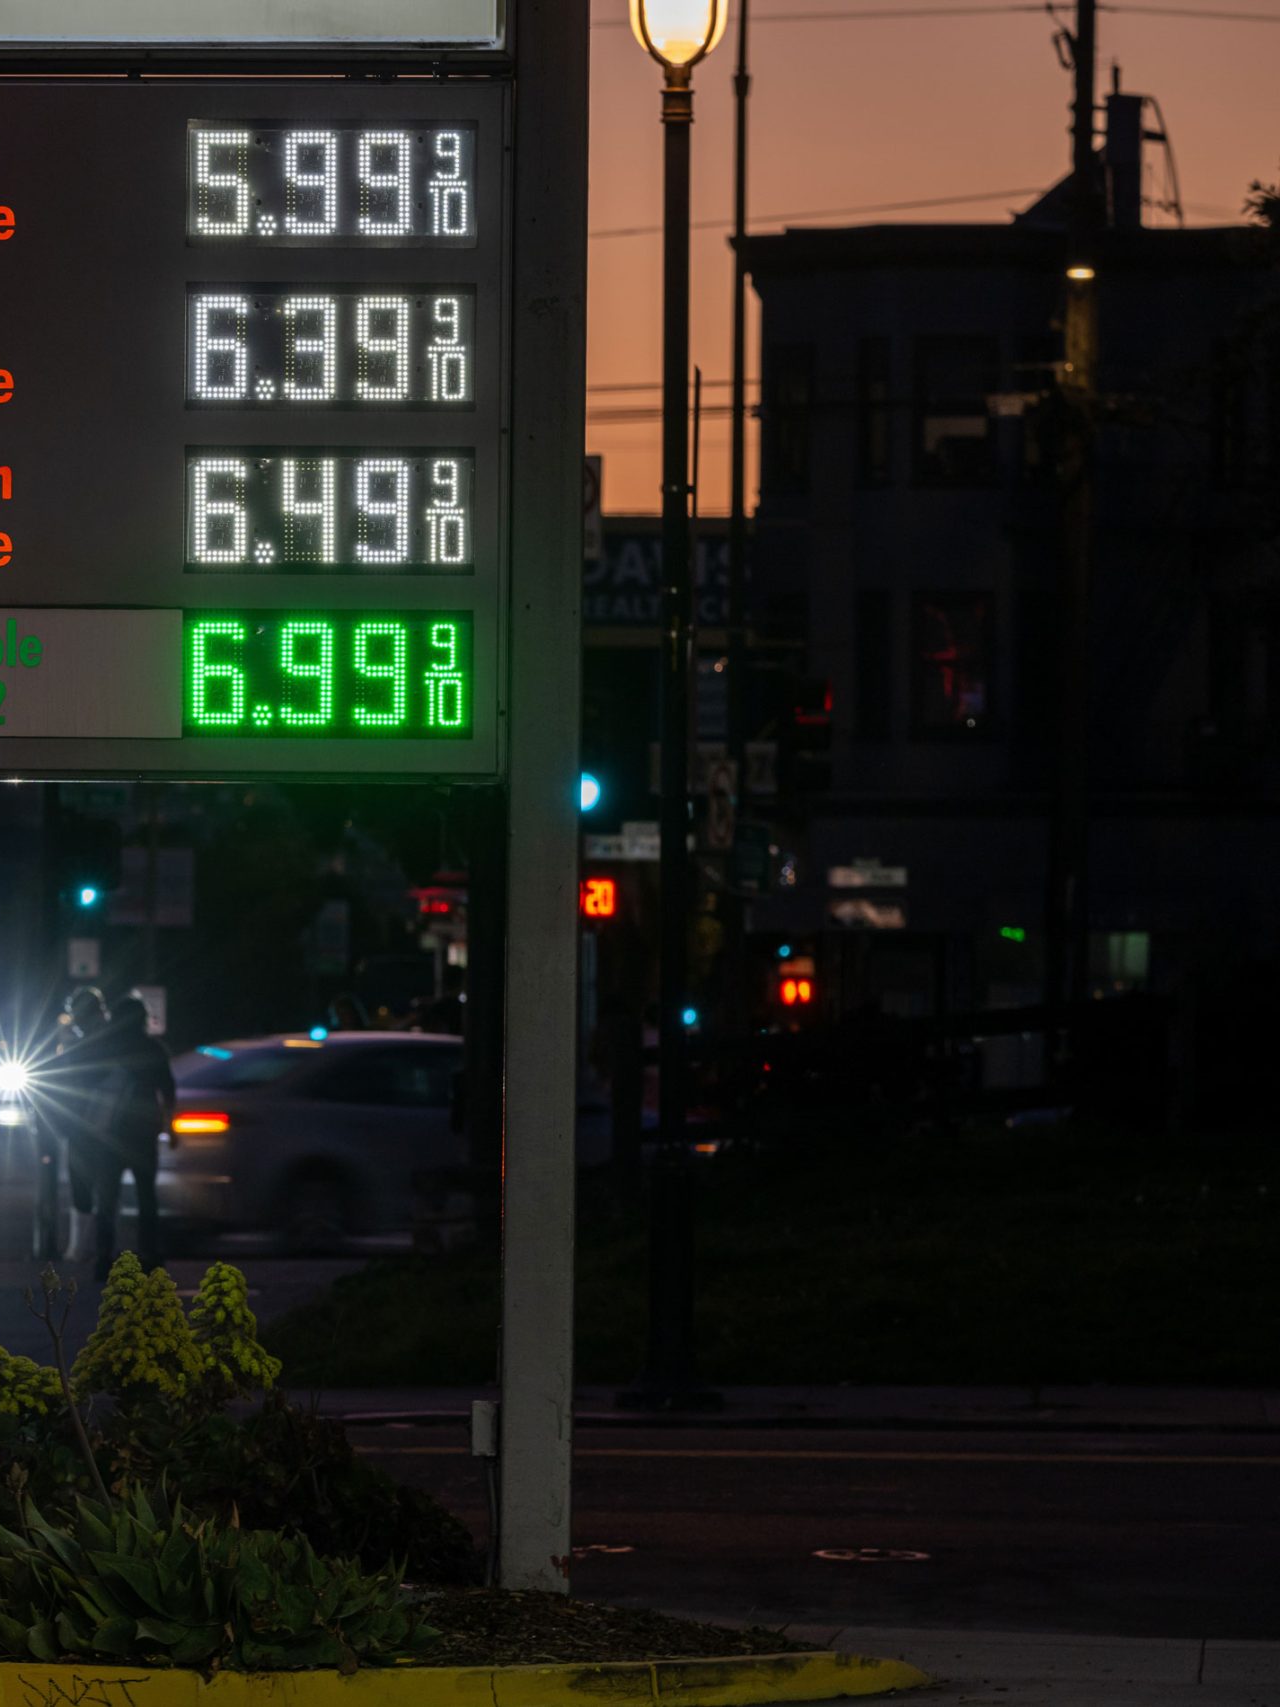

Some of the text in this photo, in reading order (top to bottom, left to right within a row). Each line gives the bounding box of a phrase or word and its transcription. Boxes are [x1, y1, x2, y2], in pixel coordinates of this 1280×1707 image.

[197, 132, 411, 235] 5.99
[195, 296, 409, 400] 6.39
[194, 460, 409, 564] 6.49
[191, 621, 407, 727] 6.99
